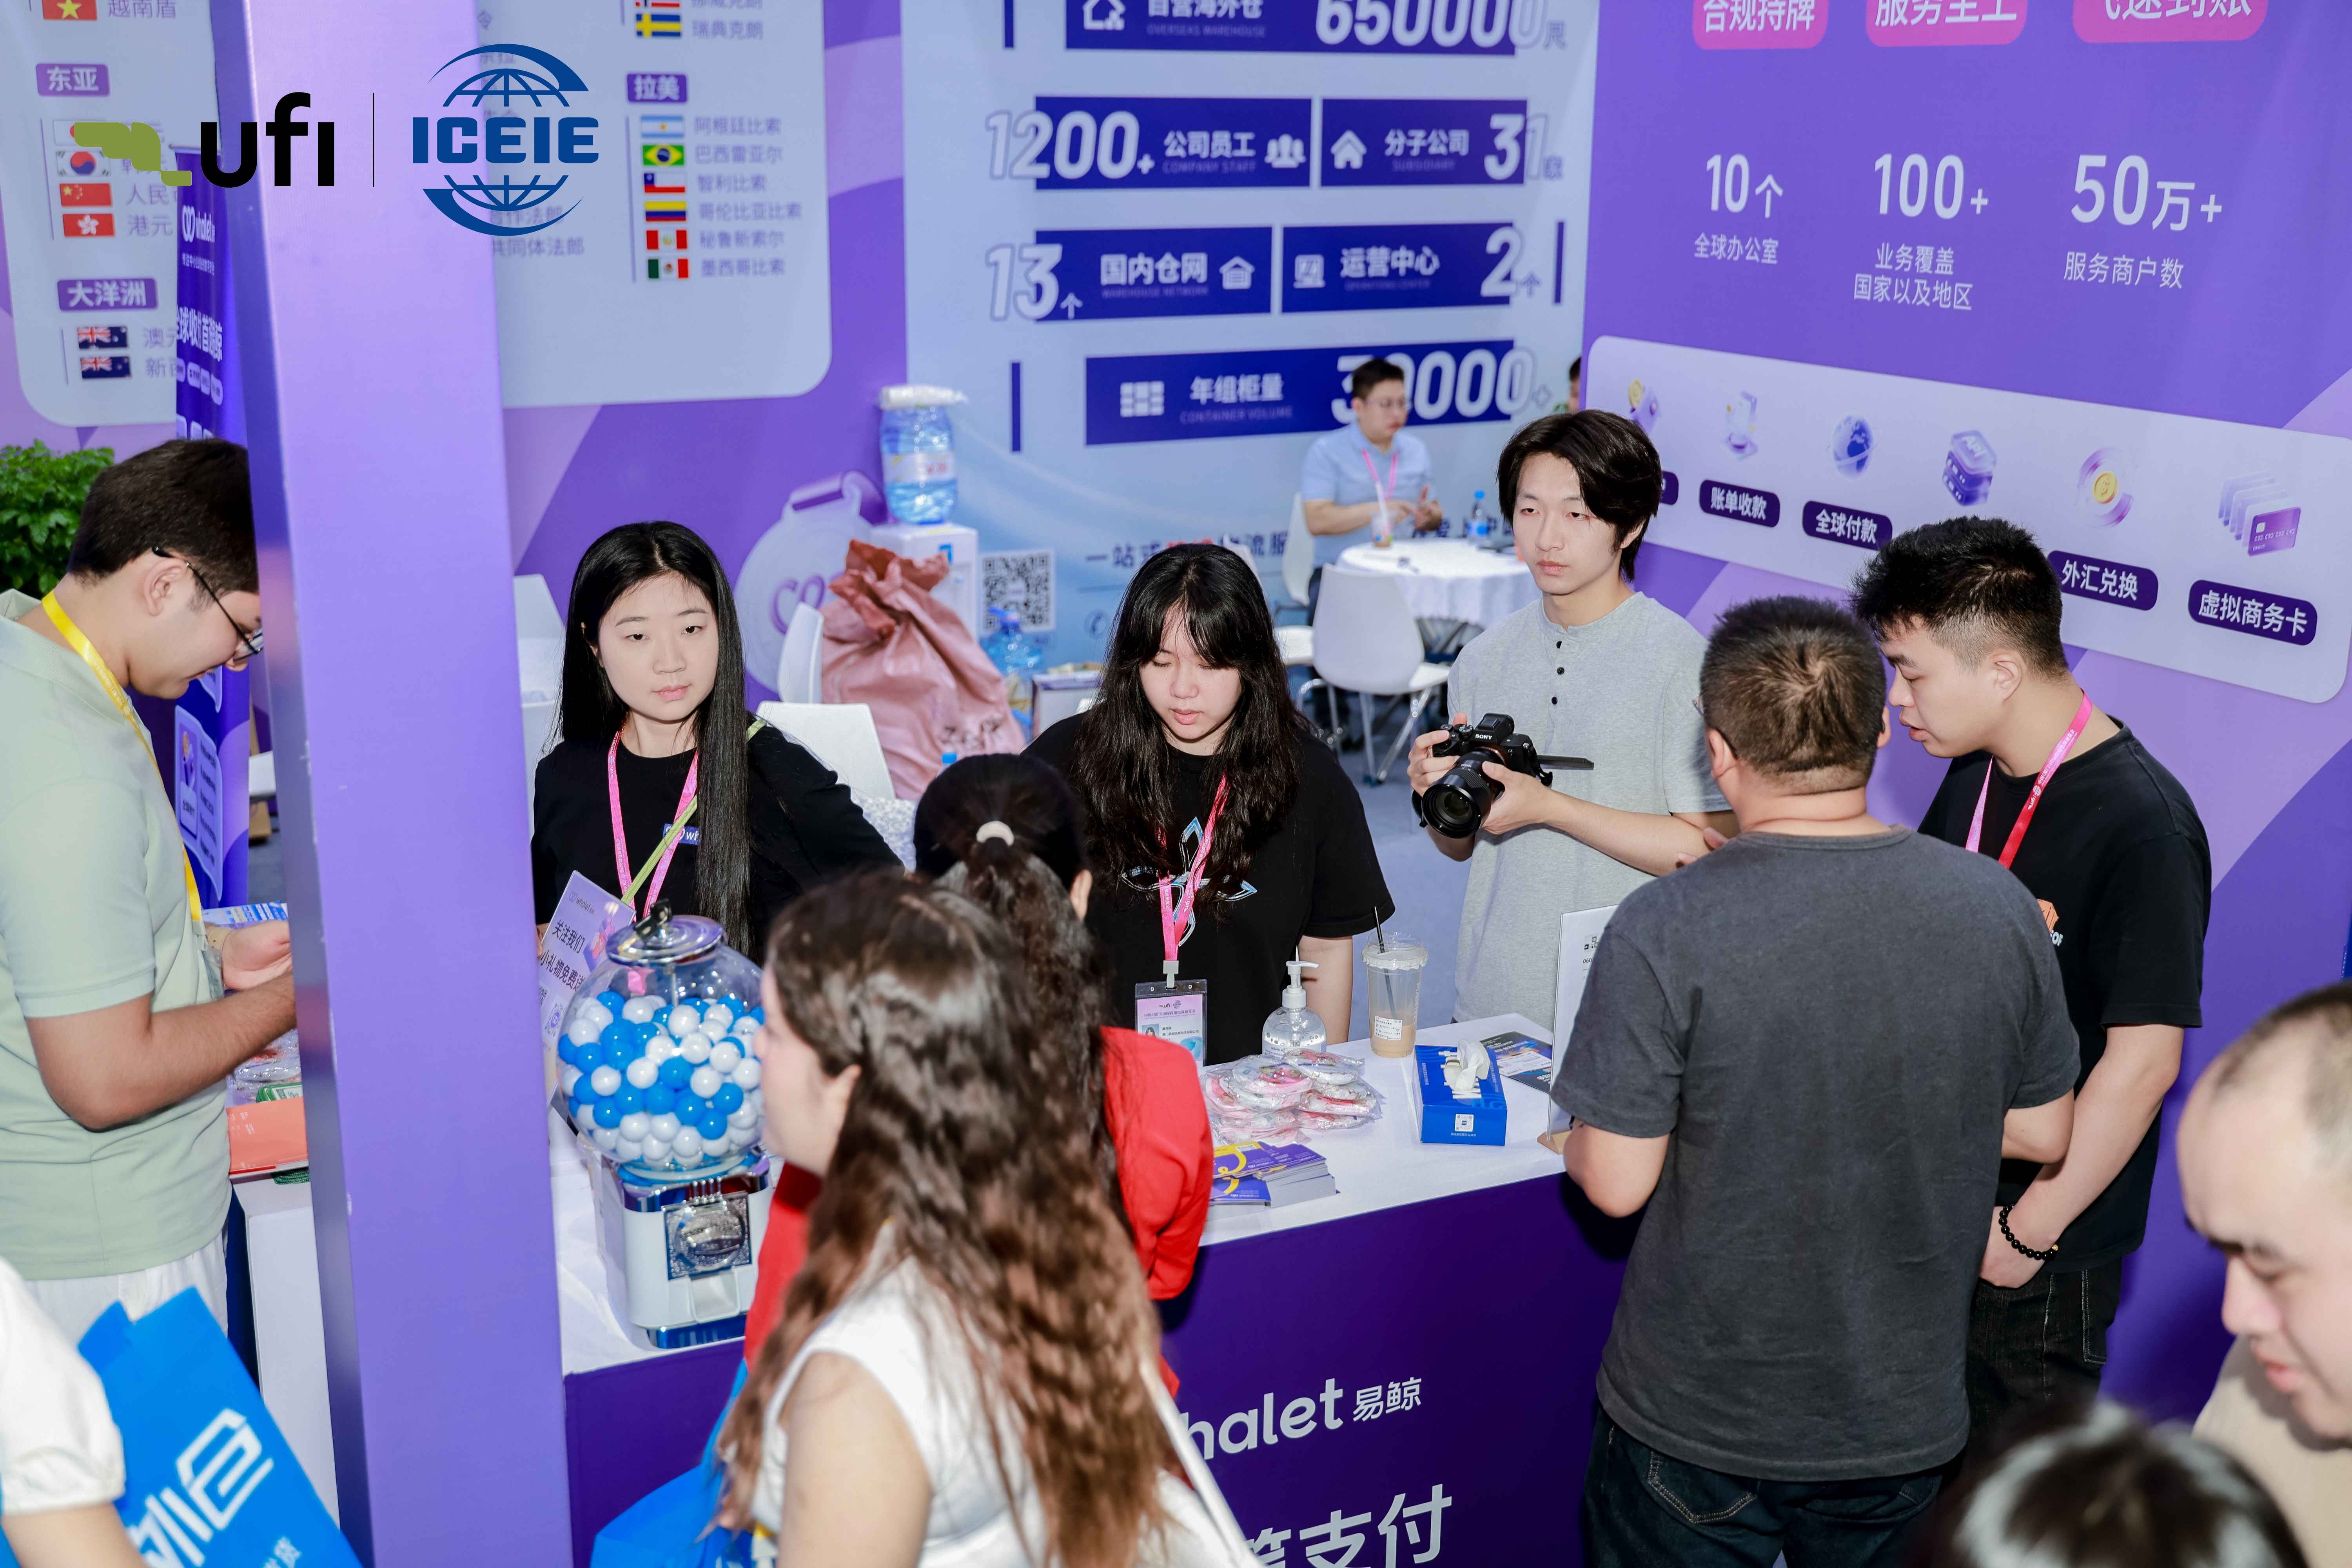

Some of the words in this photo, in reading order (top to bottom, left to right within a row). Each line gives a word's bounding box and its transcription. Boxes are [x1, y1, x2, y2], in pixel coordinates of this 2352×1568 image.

[1703, 0, 1815, 33] 合规持牌
[46, 66, 100, 92] 东亚
[633, 74, 681, 100] 拉美
[693, 117, 782, 136] 阿根廷比索
[696, 145, 782, 164] 巴西雷亚尔
[1163, 130, 1256, 158] 公司员工
[1384, 129, 1470, 157] 分子公司
[127, 183, 177, 205] 人民
[697, 174, 767, 193] 智利比索
[2071, 154, 2222, 231] 50万+
[128, 213, 173, 236] 港元
[698, 202, 803, 222] 哥伦比亚比索
[1340, 245, 1440, 278] 运营中心
[1694, 232, 1779, 265] 全球办公室
[1875, 241, 1954, 275] 业务覆盖
[701, 258, 785, 278] 墨西哥比索
[1100, 251, 1209, 286] 国内仓网
[2063, 250, 2184, 289] 服务商户数
[67, 280, 147, 308] 大洋洲
[1854, 273, 1973, 310] 国家以及地区
[1962, 435, 1987, 458] API
[1711, 486, 1767, 520] 账单收款
[1815, 508, 1878, 544] 全球付款
[2061, 559, 2138, 601] 外汇兑换
[2198, 590, 2308, 637] 虚拟商务卡
[576, 897, 591, 911] whalet
[552, 919, 585, 954] 关注我们
[2050, 929, 2063, 946] OF
[1180, 1378, 1343, 1460] halet
[1353, 1376, 1422, 1422] 易鲸
